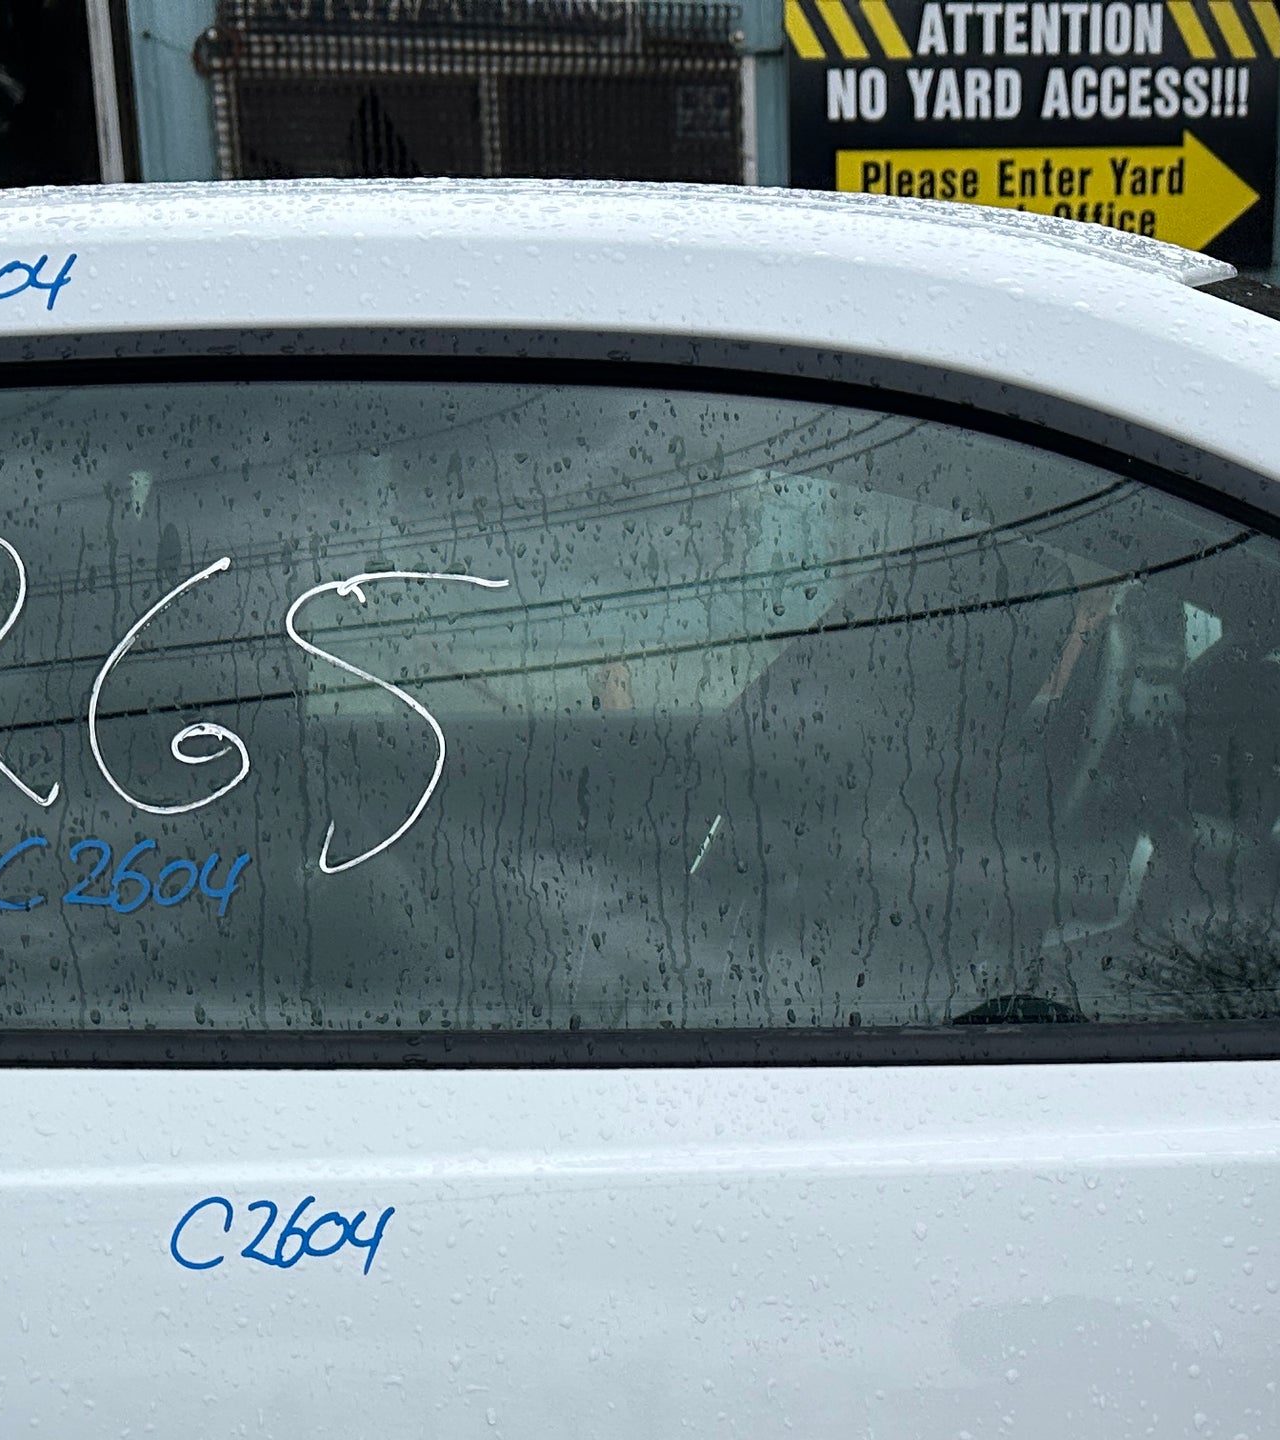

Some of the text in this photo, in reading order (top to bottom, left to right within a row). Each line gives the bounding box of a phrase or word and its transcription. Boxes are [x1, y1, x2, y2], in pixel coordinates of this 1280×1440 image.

[916, 2, 1163, 56] ATTENTION
[826, 66, 1250, 121] NO YARD ACCESS!!!
[861, 156, 1185, 199] Please Enter Yard
